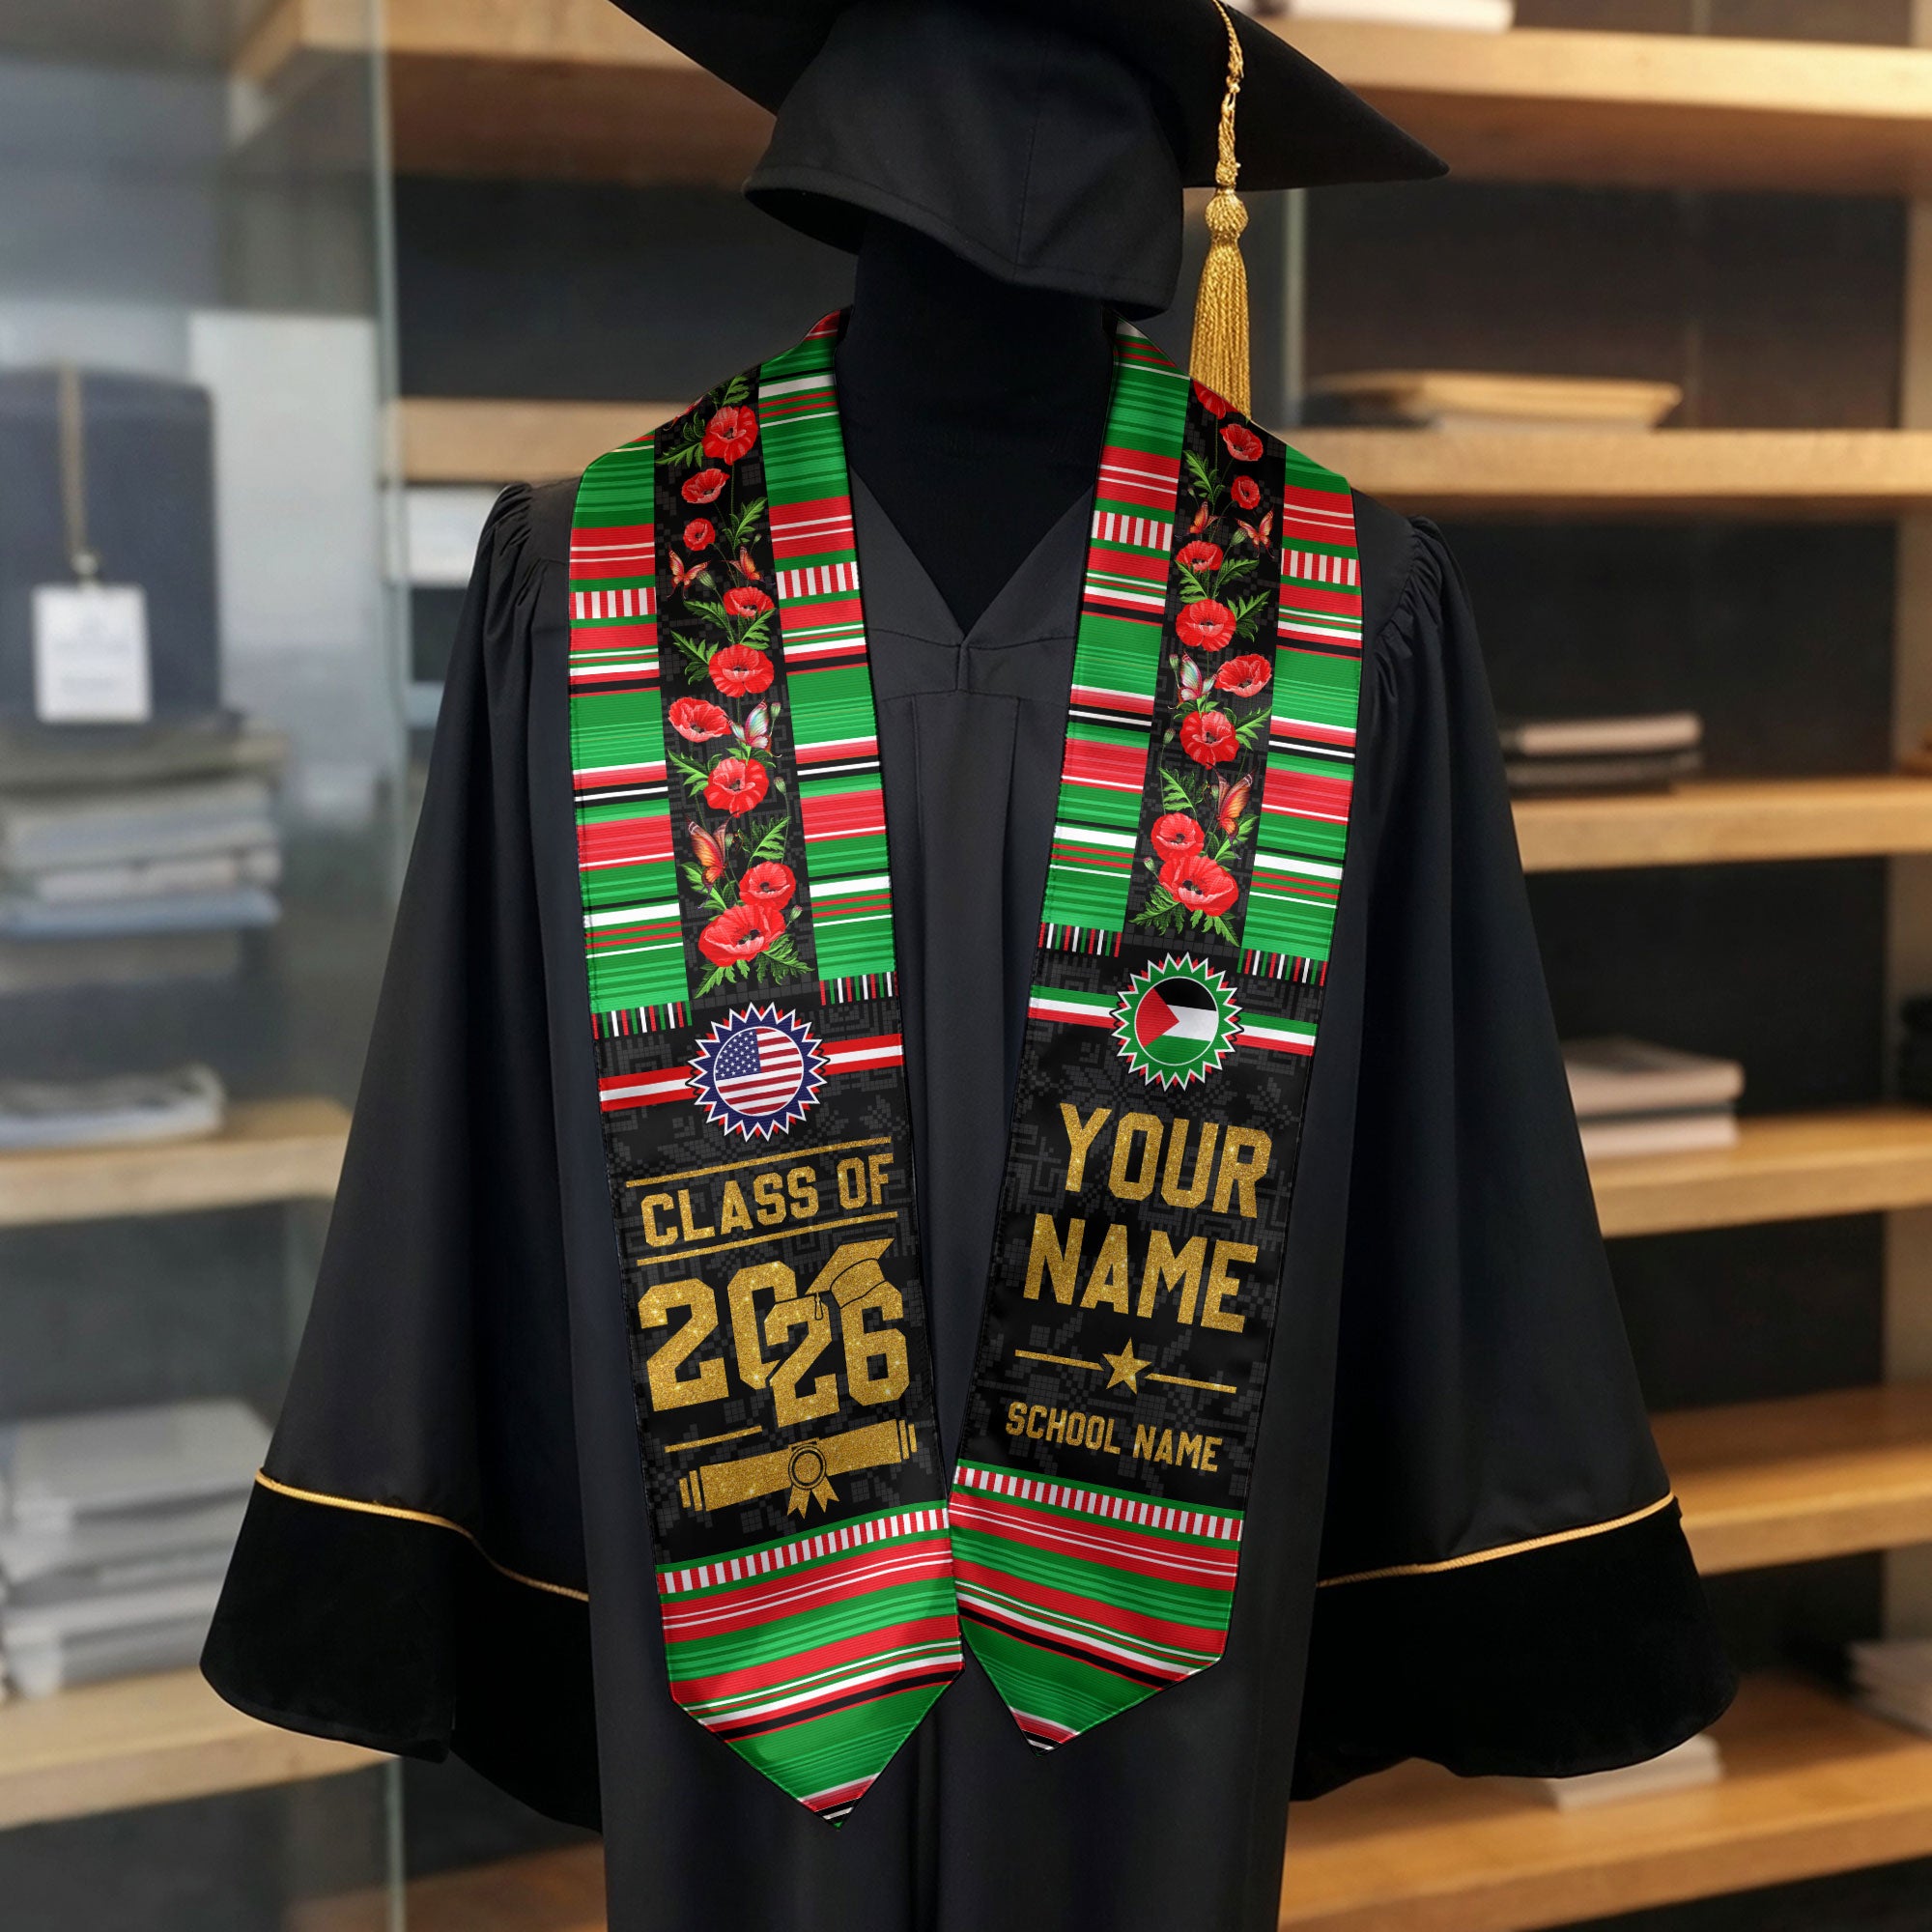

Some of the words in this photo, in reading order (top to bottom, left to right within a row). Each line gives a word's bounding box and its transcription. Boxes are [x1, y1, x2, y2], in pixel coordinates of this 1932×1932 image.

[640, 1166, 819, 1248] CLASS
[838, 1152, 895, 1211] OF
[1059, 1102, 1273, 1219] YOUR
[1022, 1212, 1259, 1333] NAME
[638, 1261, 910, 1429] 2026
[1006, 1401, 1121, 1455] SCHOOL
[1132, 1423, 1224, 1473] NAME
